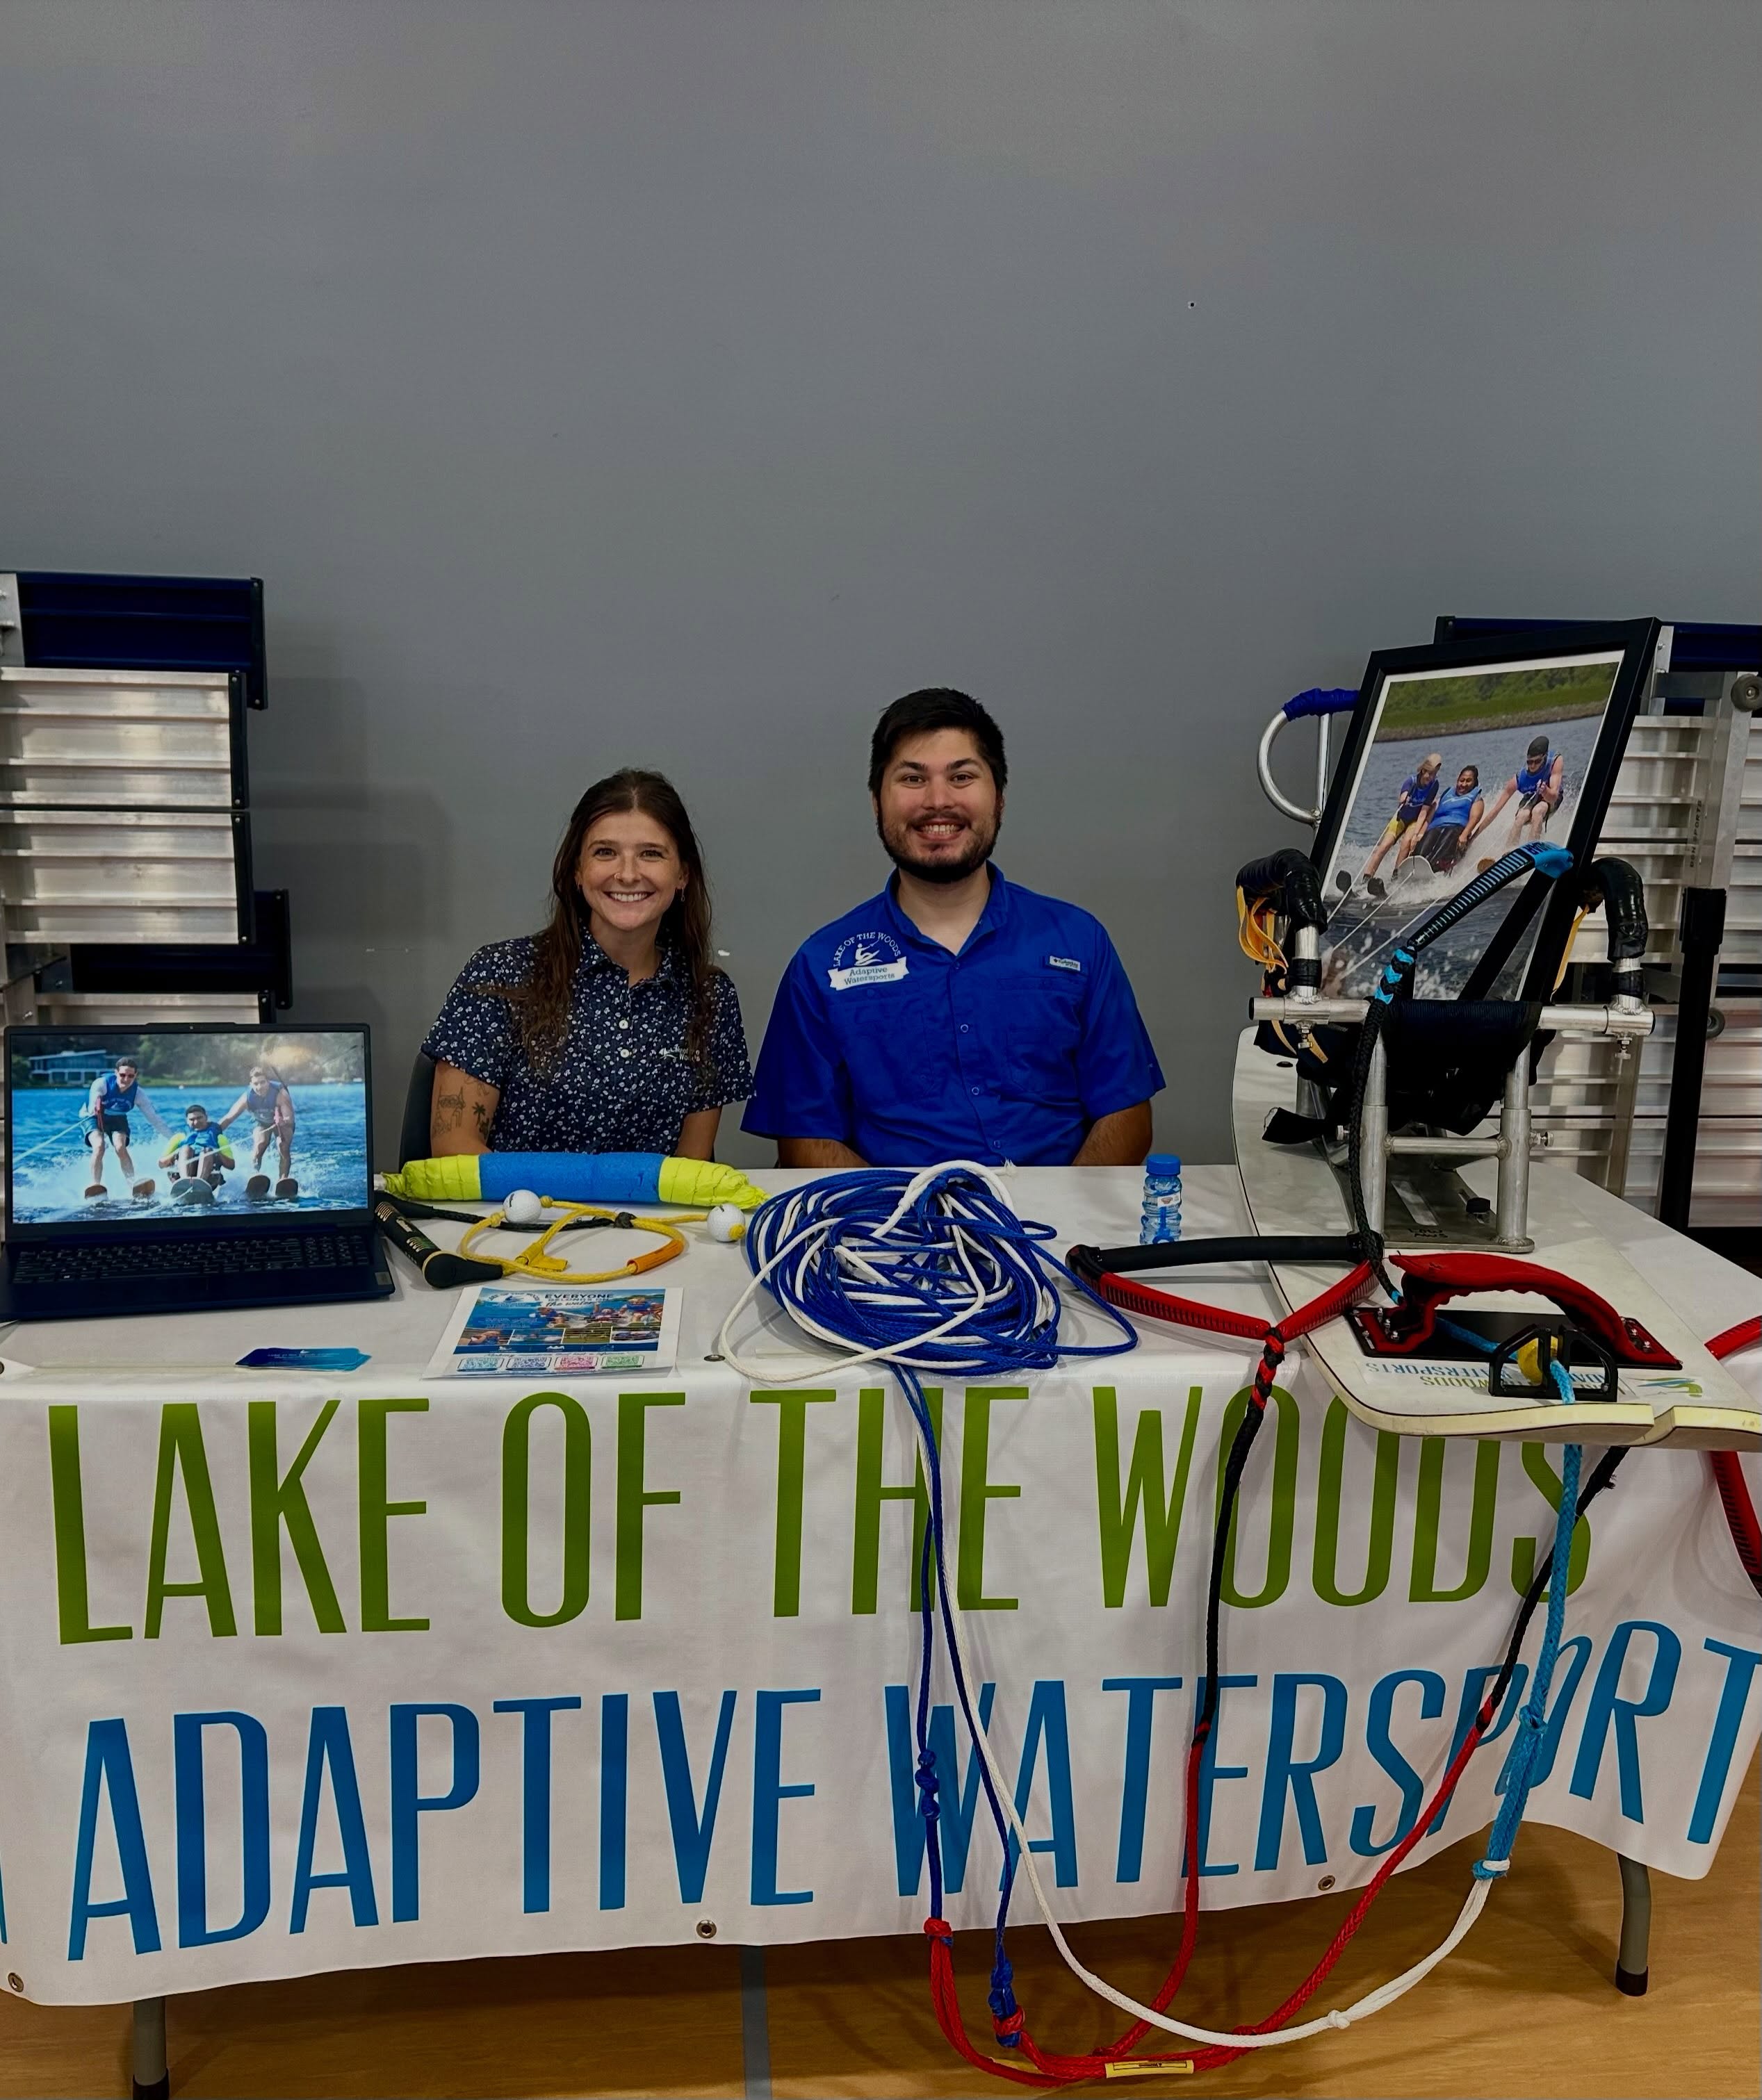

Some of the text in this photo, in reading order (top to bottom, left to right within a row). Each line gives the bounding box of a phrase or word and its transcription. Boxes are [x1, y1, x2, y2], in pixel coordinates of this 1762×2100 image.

[833, 931, 901, 967] LAKE OF THE WOODS
[844, 973, 895, 985] Watersports
[849, 967, 888, 977] Adaptive
[1365, 1363, 1512, 1381] TERSPORTS
[48, 1386, 1591, 1646] LAKE OF THE WOODS
[68, 1688, 822, 1962] ADAPTIVE
